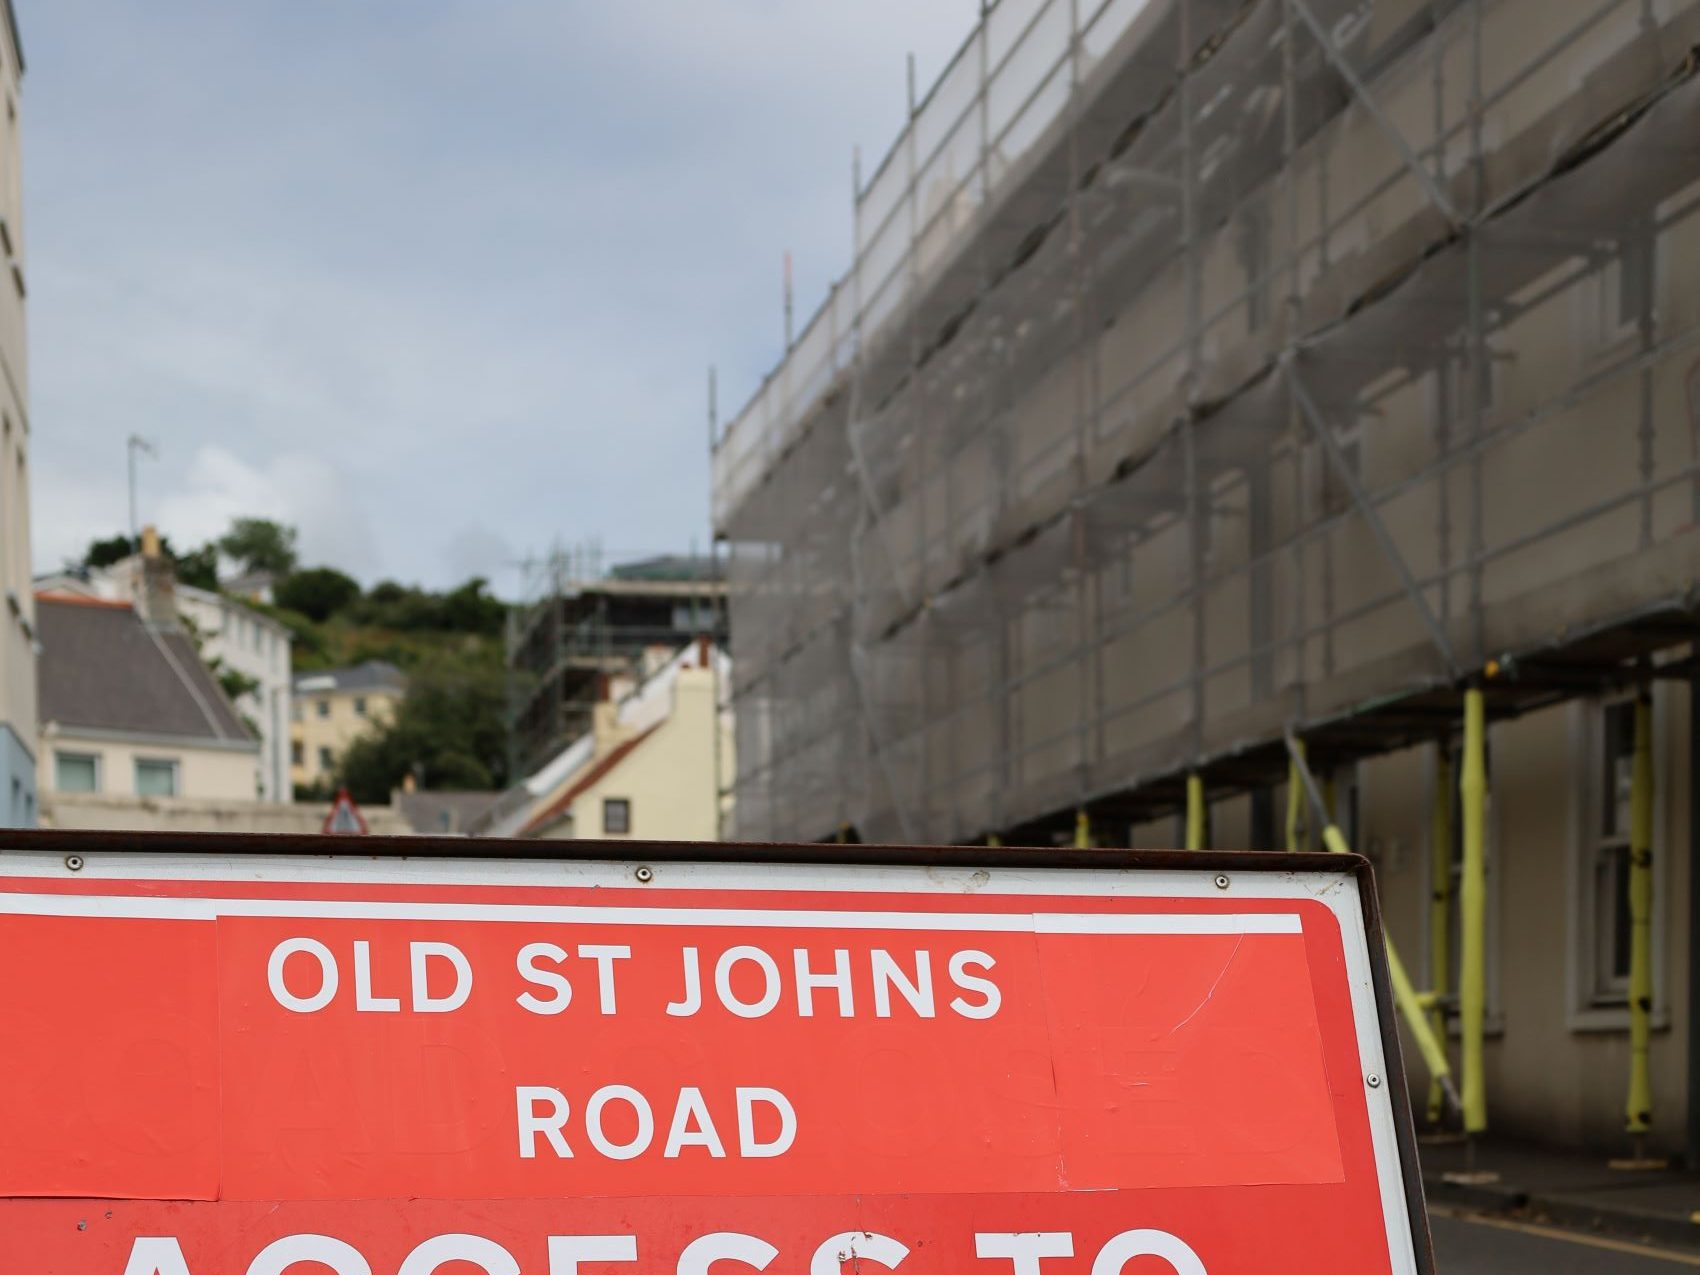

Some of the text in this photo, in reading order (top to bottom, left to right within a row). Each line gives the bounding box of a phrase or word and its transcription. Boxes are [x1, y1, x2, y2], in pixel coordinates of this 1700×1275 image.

[268, 937, 1001, 1020] OLD ST JOHNS
[516, 1085, 798, 1160] ROAD
